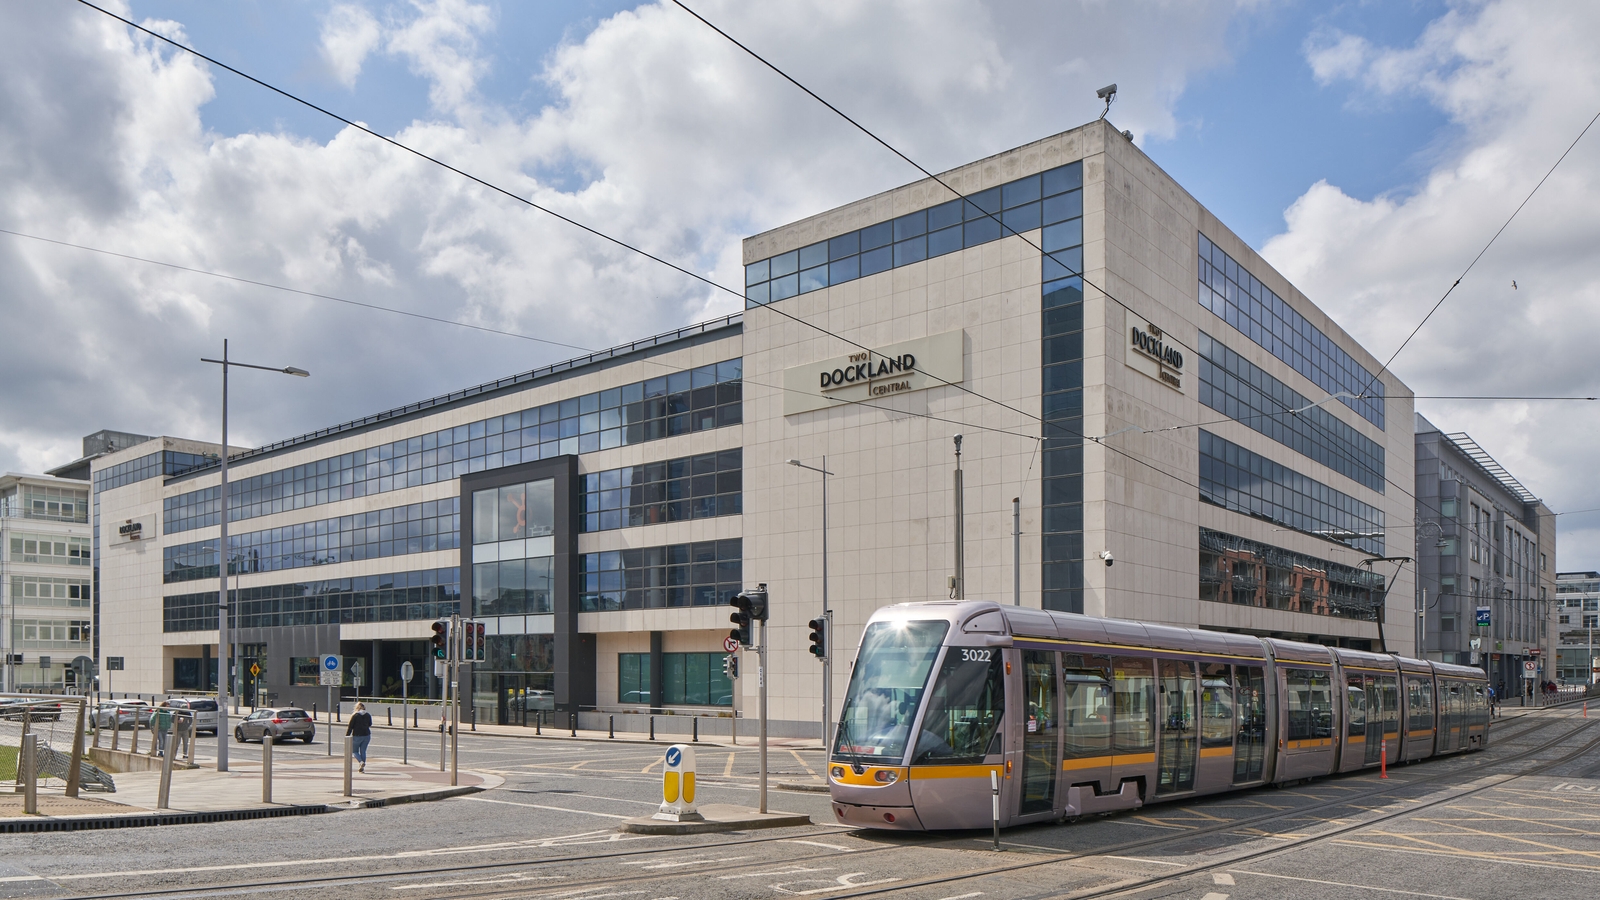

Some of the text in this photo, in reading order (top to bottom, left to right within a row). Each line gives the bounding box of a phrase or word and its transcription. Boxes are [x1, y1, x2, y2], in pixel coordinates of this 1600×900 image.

[1132, 327, 1183, 369] DOCKLAND
[848, 352, 867, 362] TWO
[820, 353, 915, 388] DOCKLAND
[872, 380, 911, 396] CENTRAL
[961, 648, 991, 663] 3022
